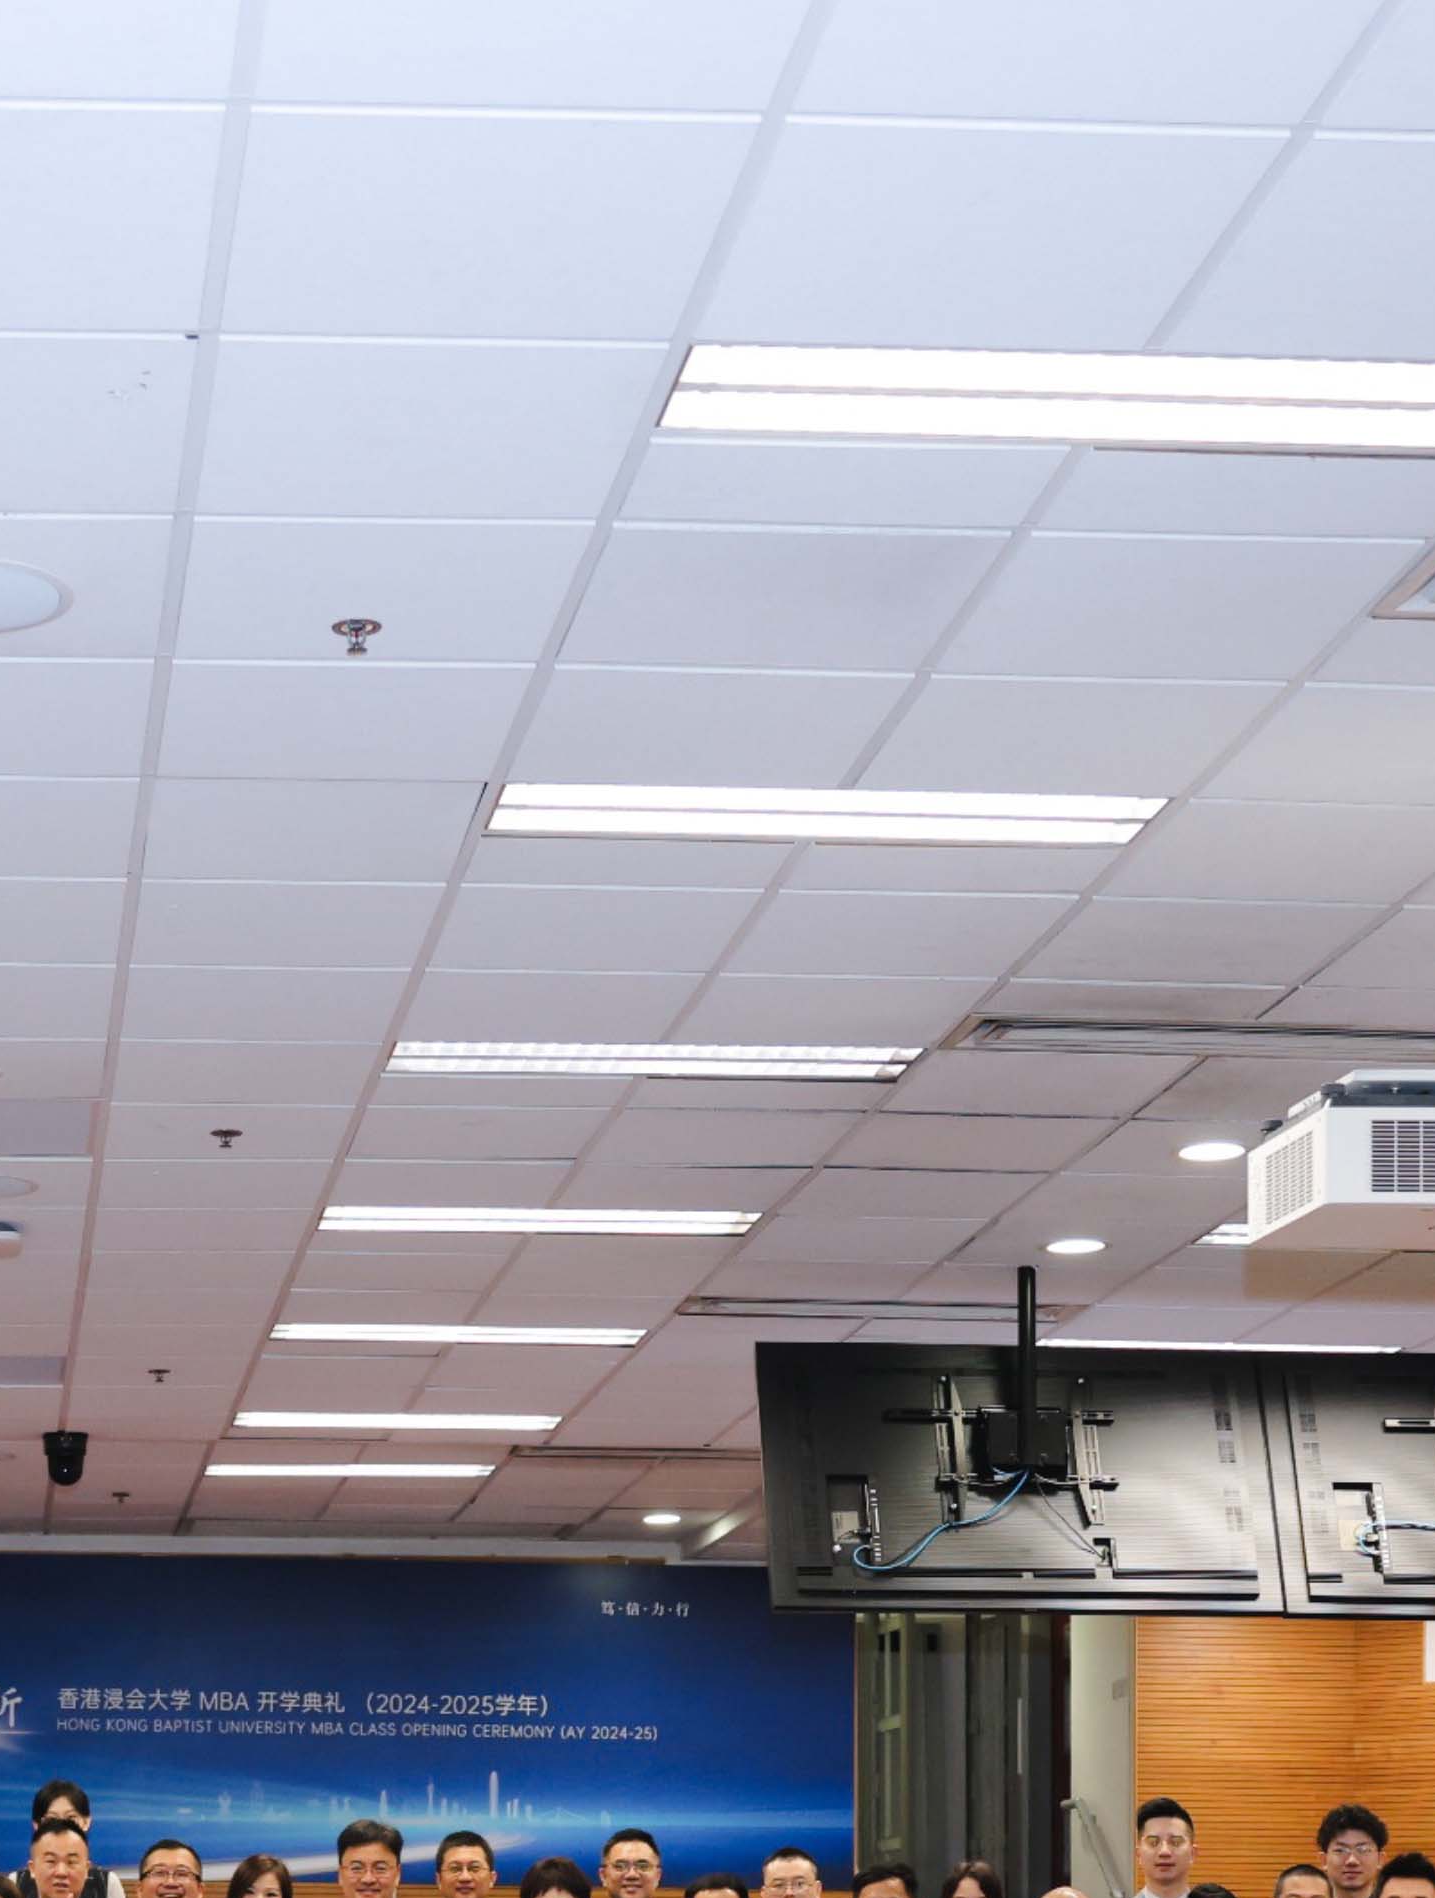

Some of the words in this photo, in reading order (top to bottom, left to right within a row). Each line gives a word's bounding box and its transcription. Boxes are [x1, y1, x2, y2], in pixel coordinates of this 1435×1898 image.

[58, 1688, 191, 1711] 香港浸会大学
[199, 1692, 249, 1711] MBA
[257, 1691, 345, 1713] 开学典礼
[57, 1717, 100, 1732] HONG
[106, 1718, 147, 1733] KONG
[153, 1719, 213, 1733] BAPTIST
[219, 1720, 305, 1735] UNIVERSITY
[311, 1722, 343, 1736] MBA
[349, 1722, 396, 1737] CLASS
[402, 1724, 467, 1738] OPENING
[473, 1724, 555, 1739] CEREMONY
[561, 1725, 586, 1740] (AY
[592, 1726, 658, 1741] 2024-25)
